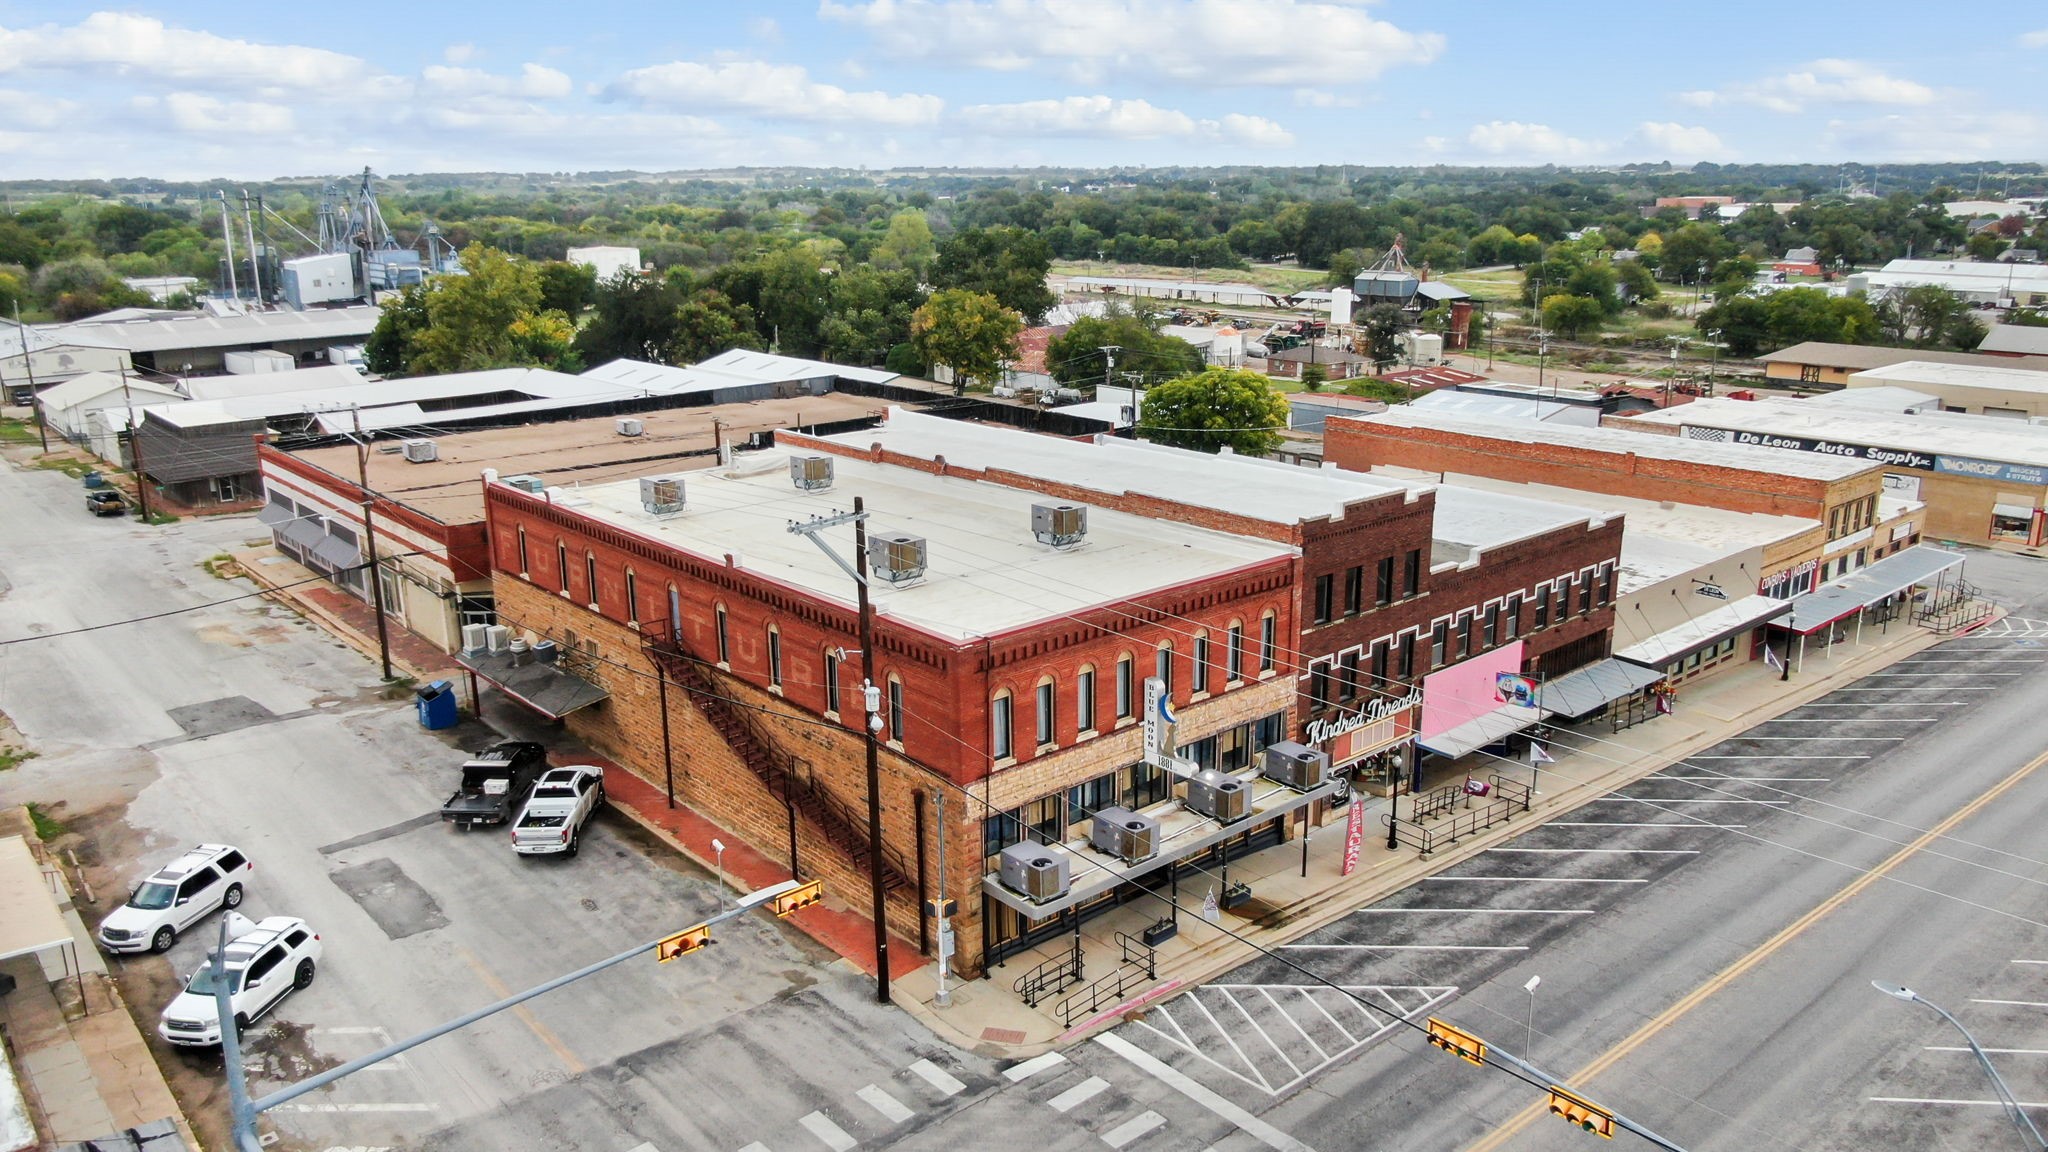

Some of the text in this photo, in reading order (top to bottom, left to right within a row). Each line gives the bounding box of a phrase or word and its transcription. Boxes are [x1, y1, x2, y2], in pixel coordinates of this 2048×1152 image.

[1739, 433, 1760, 445] De
[1761, 434, 1801, 449] Leon
[1813, 441, 1856, 456] Auto
[1943, 459, 1997, 475] MONROE
[1305, 683, 1422, 748] Kindred Threads
[1147, 719, 1155, 748] MOON
[1157, 755, 1174, 771] 1881
[1345, 803, 1361, 873] RESTAURANT
